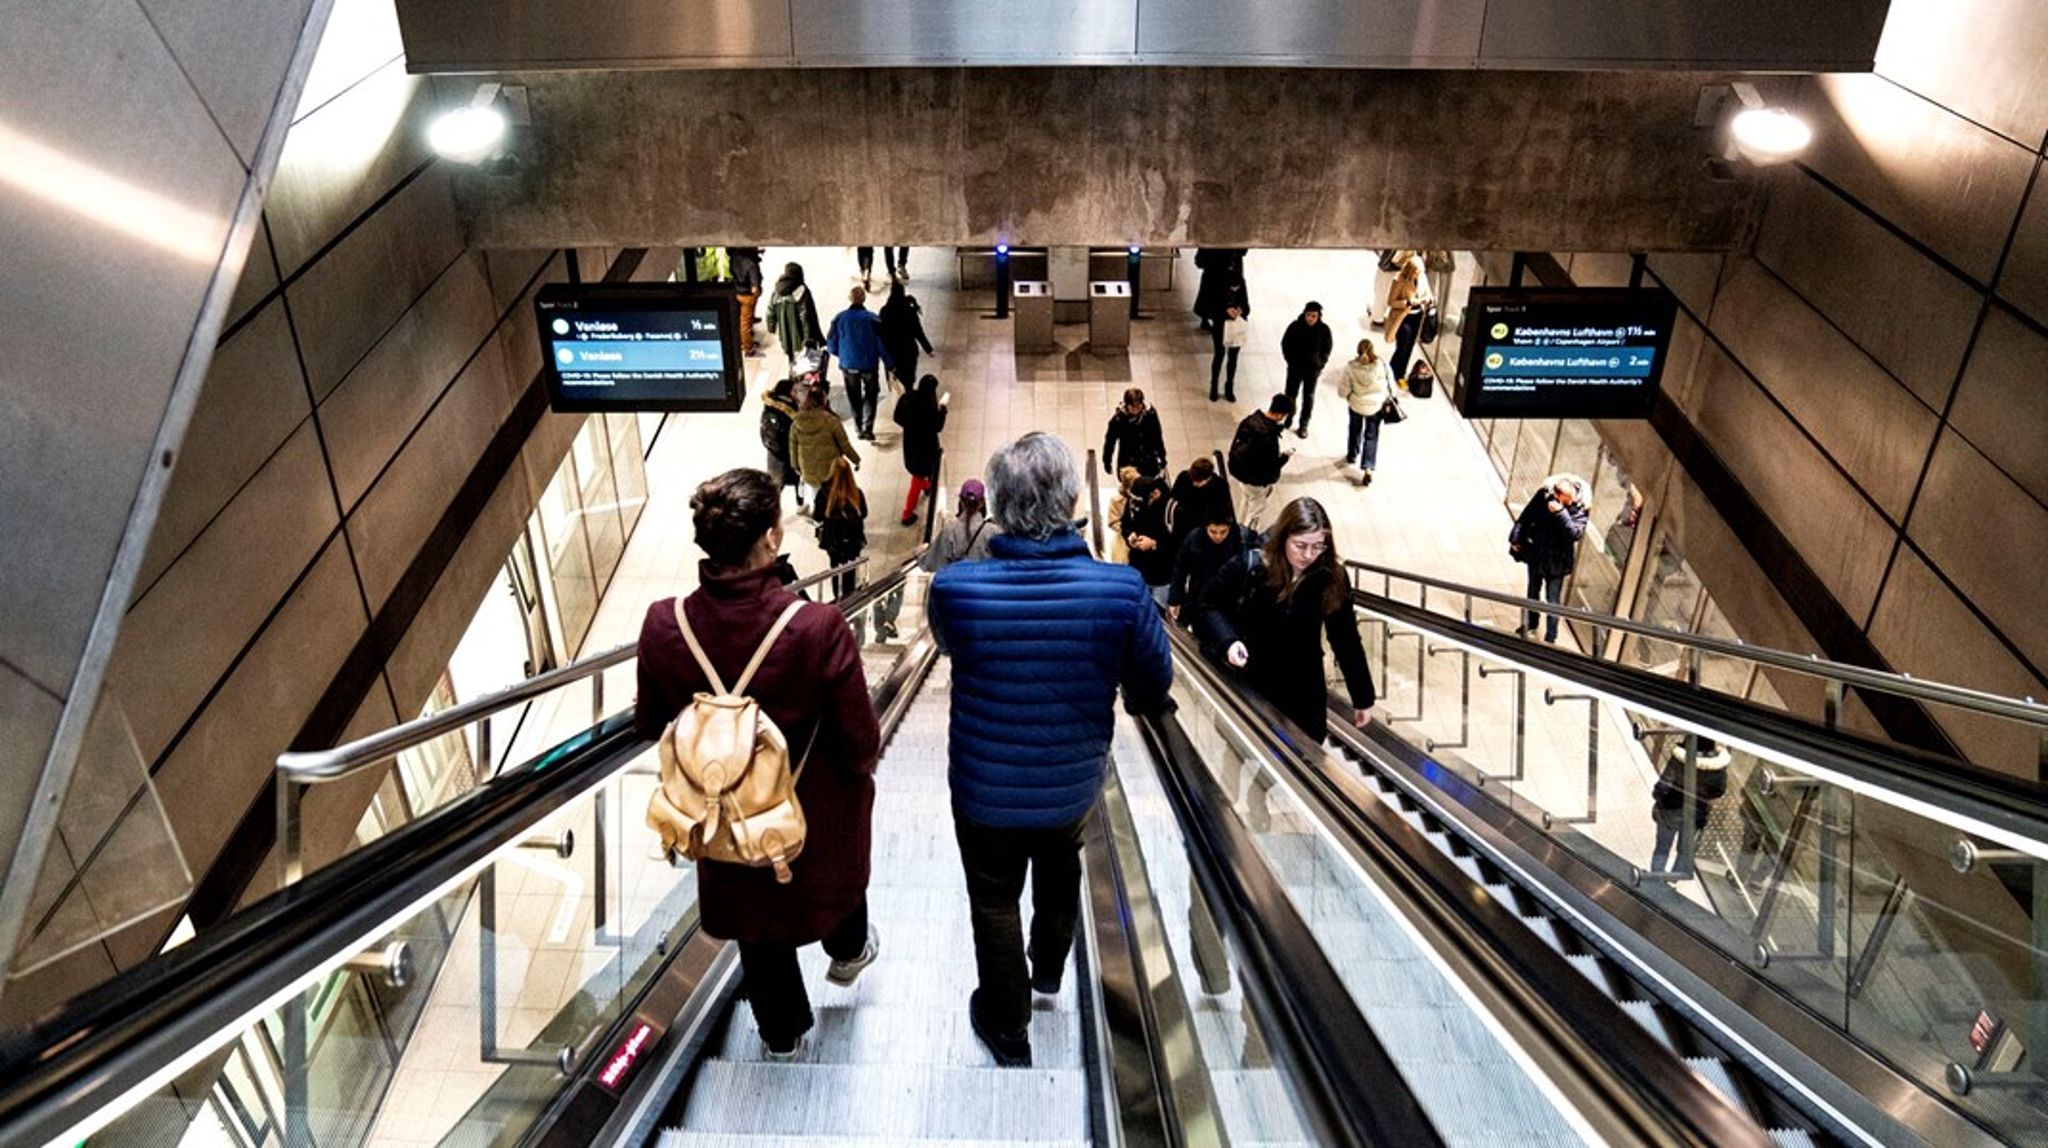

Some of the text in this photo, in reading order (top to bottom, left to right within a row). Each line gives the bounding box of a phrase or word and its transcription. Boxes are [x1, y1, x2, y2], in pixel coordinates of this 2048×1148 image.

[1514, 327, 1614, 337] Københavns Lufthavn
[1509, 358, 1606, 367] Københavns Lufthavn
